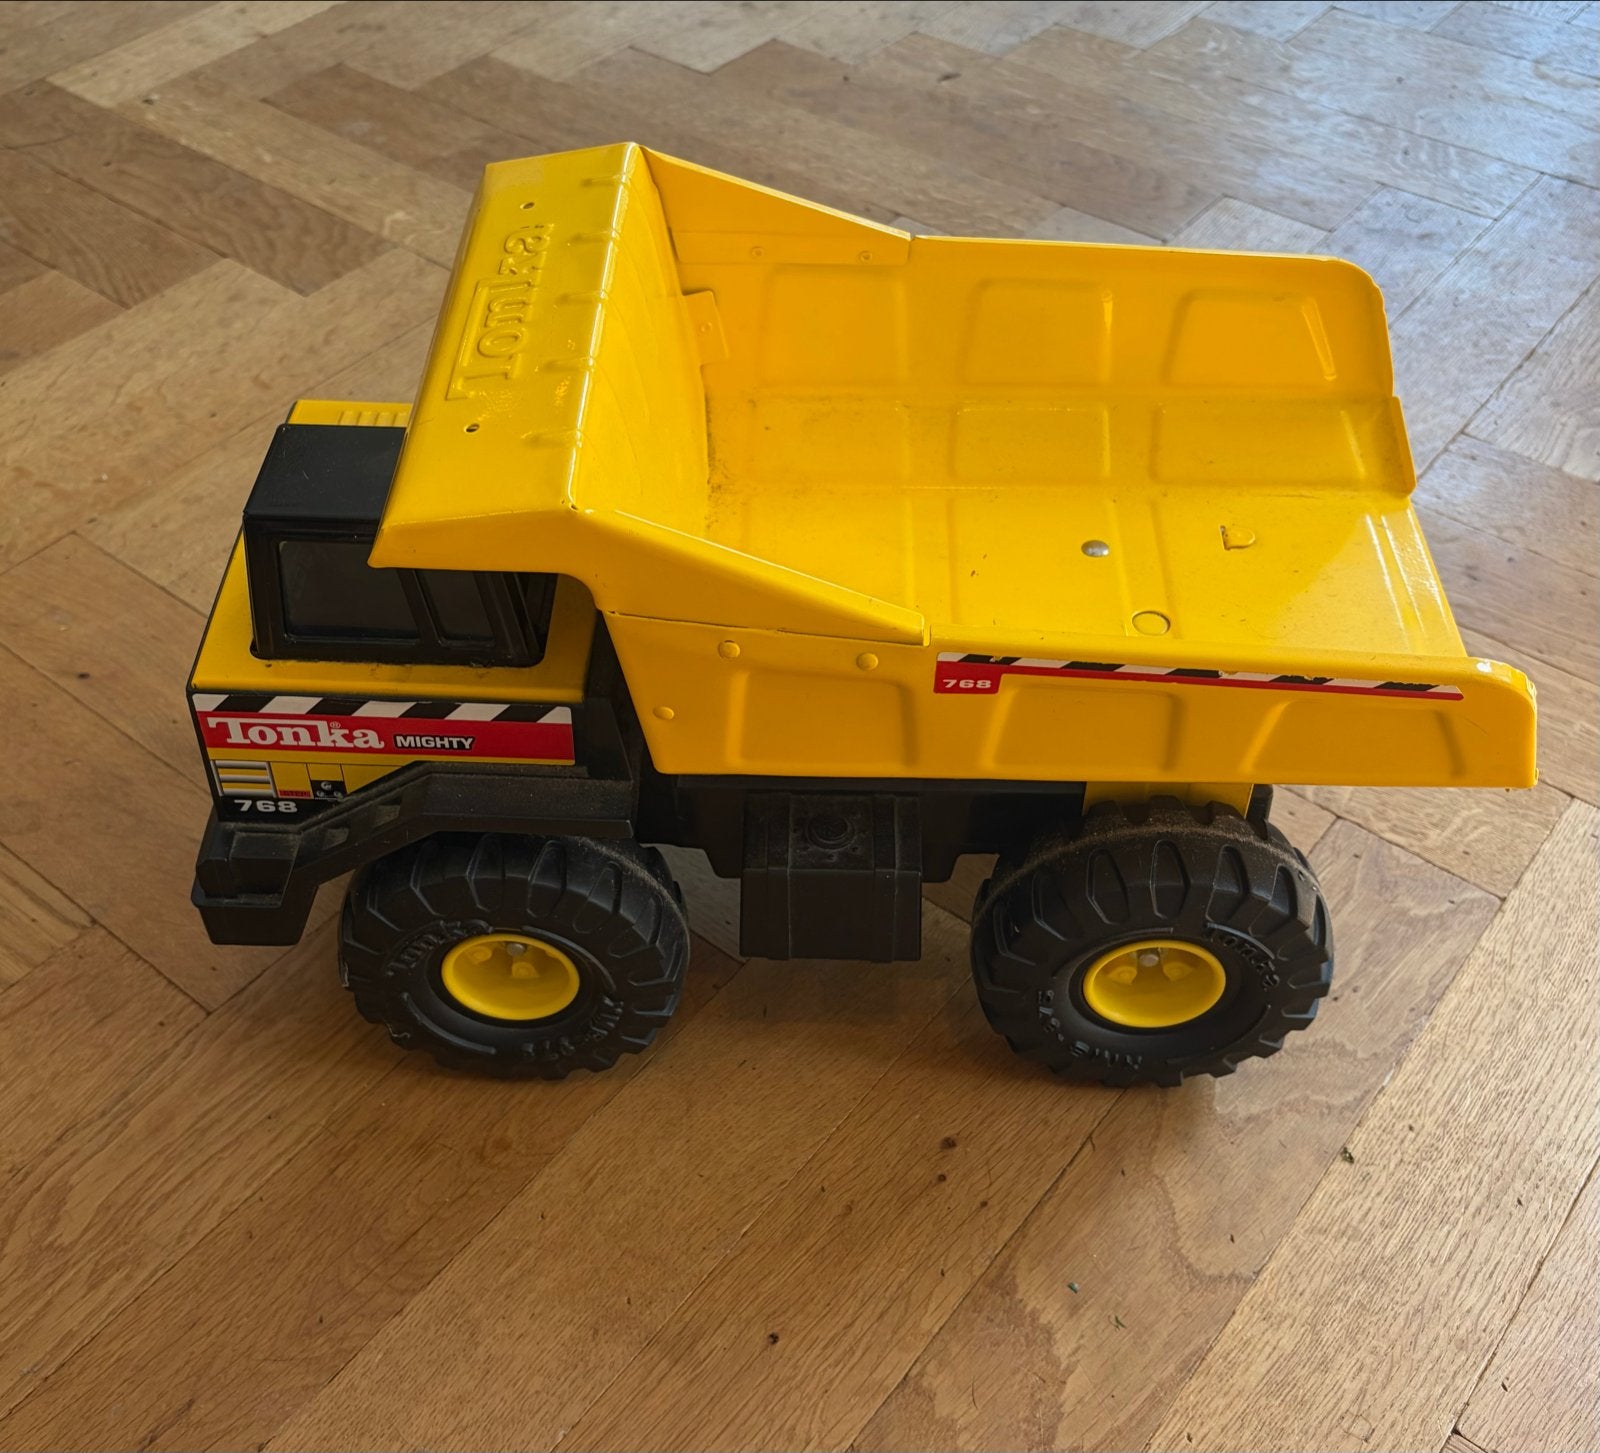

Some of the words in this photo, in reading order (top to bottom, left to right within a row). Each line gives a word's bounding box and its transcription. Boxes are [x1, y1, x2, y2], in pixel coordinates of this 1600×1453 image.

[445, 222, 554, 401] Tonka
[942, 678, 992, 689] 768
[207, 716, 385, 749] Tonka
[395, 735, 473, 749] MIGHTY
[233, 799, 298, 813] 768
